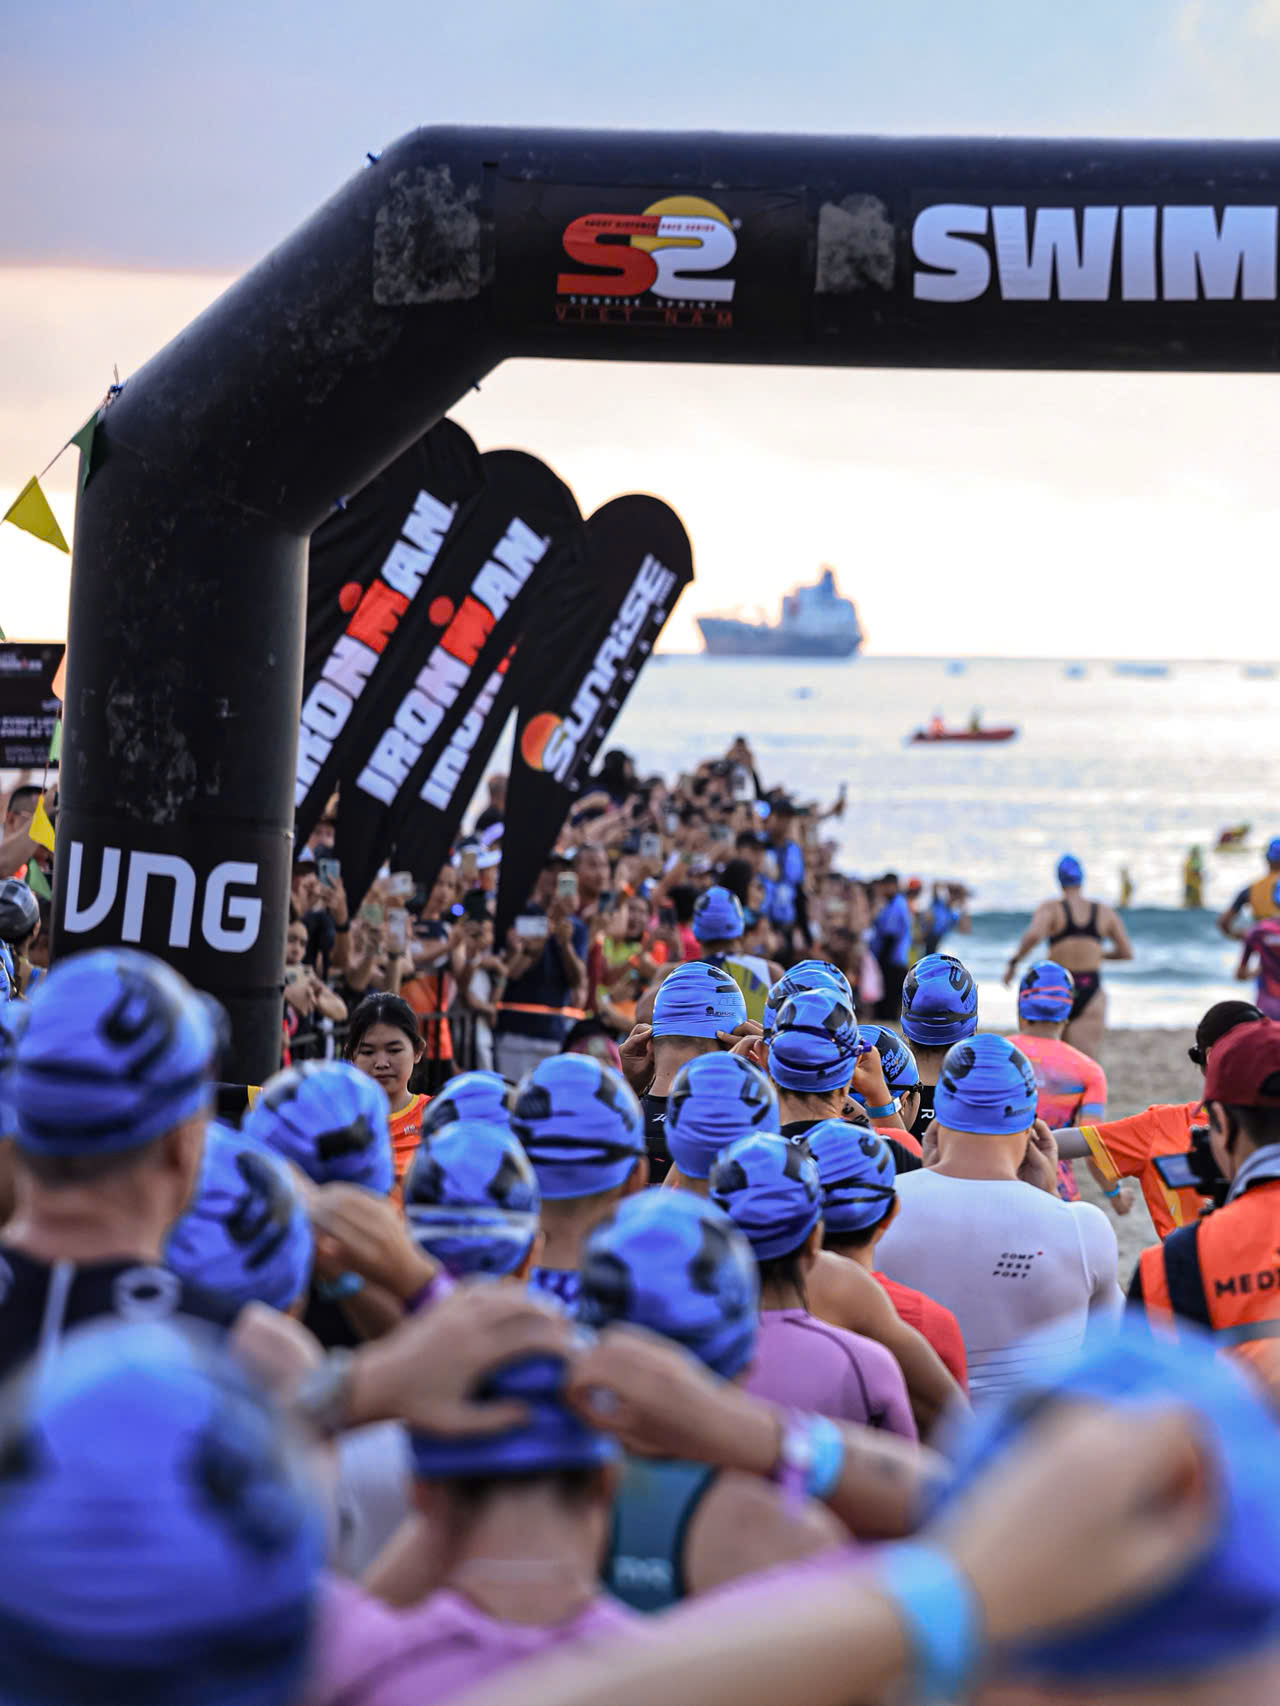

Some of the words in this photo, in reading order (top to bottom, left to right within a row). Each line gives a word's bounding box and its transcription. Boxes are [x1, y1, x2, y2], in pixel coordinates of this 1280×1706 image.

[557, 213, 737, 300] S2
[912, 204, 1278, 302] SWIM
[295, 489, 454, 808] RONMAN
[356, 517, 549, 807] IRONMAN
[64, 841, 262, 953] VNG
[993, 1271, 1028, 1279] PORT
[1001, 1252, 1034, 1260] COMP
